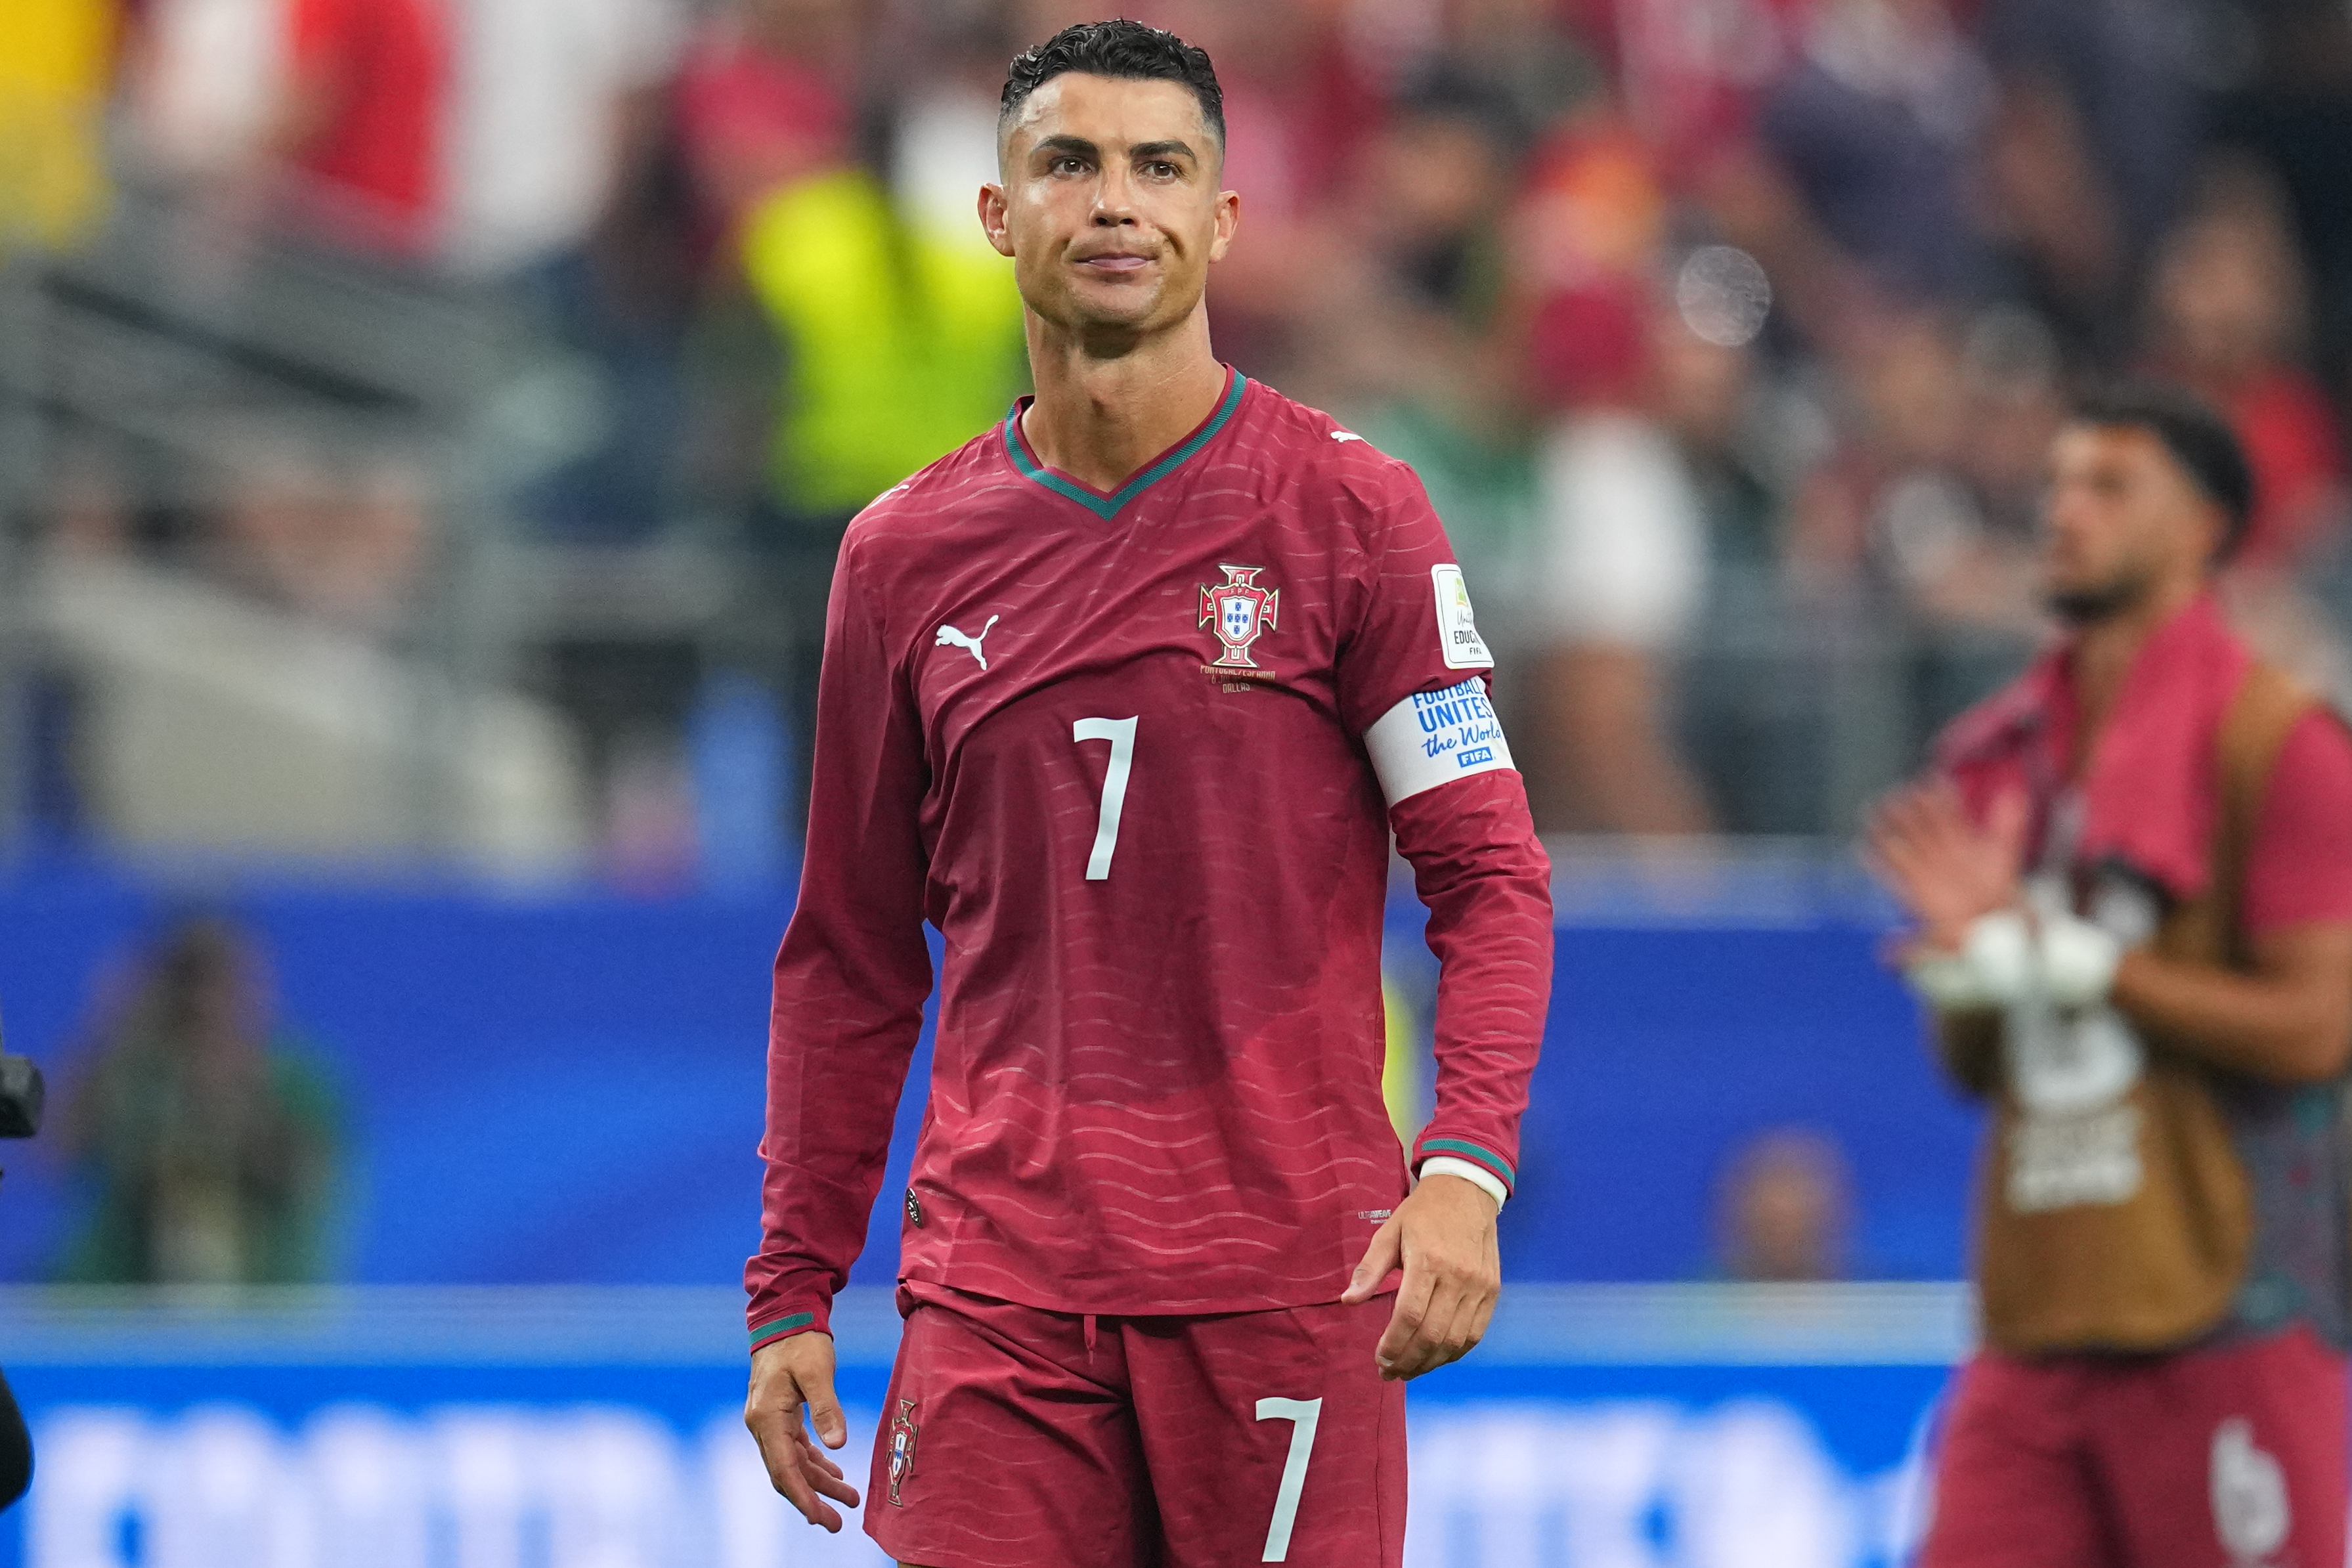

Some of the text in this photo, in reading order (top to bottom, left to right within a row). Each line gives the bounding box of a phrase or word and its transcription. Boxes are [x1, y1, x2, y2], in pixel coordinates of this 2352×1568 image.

[1412, 679, 1483, 708] FOOTBALL
[1418, 697, 1493, 733] UNITES
[1421, 720, 1503, 758] the World
[1460, 749, 1491, 765] FIFA
[1073, 715, 1139, 881] 7
[1255, 1397, 1322, 1563] 7
